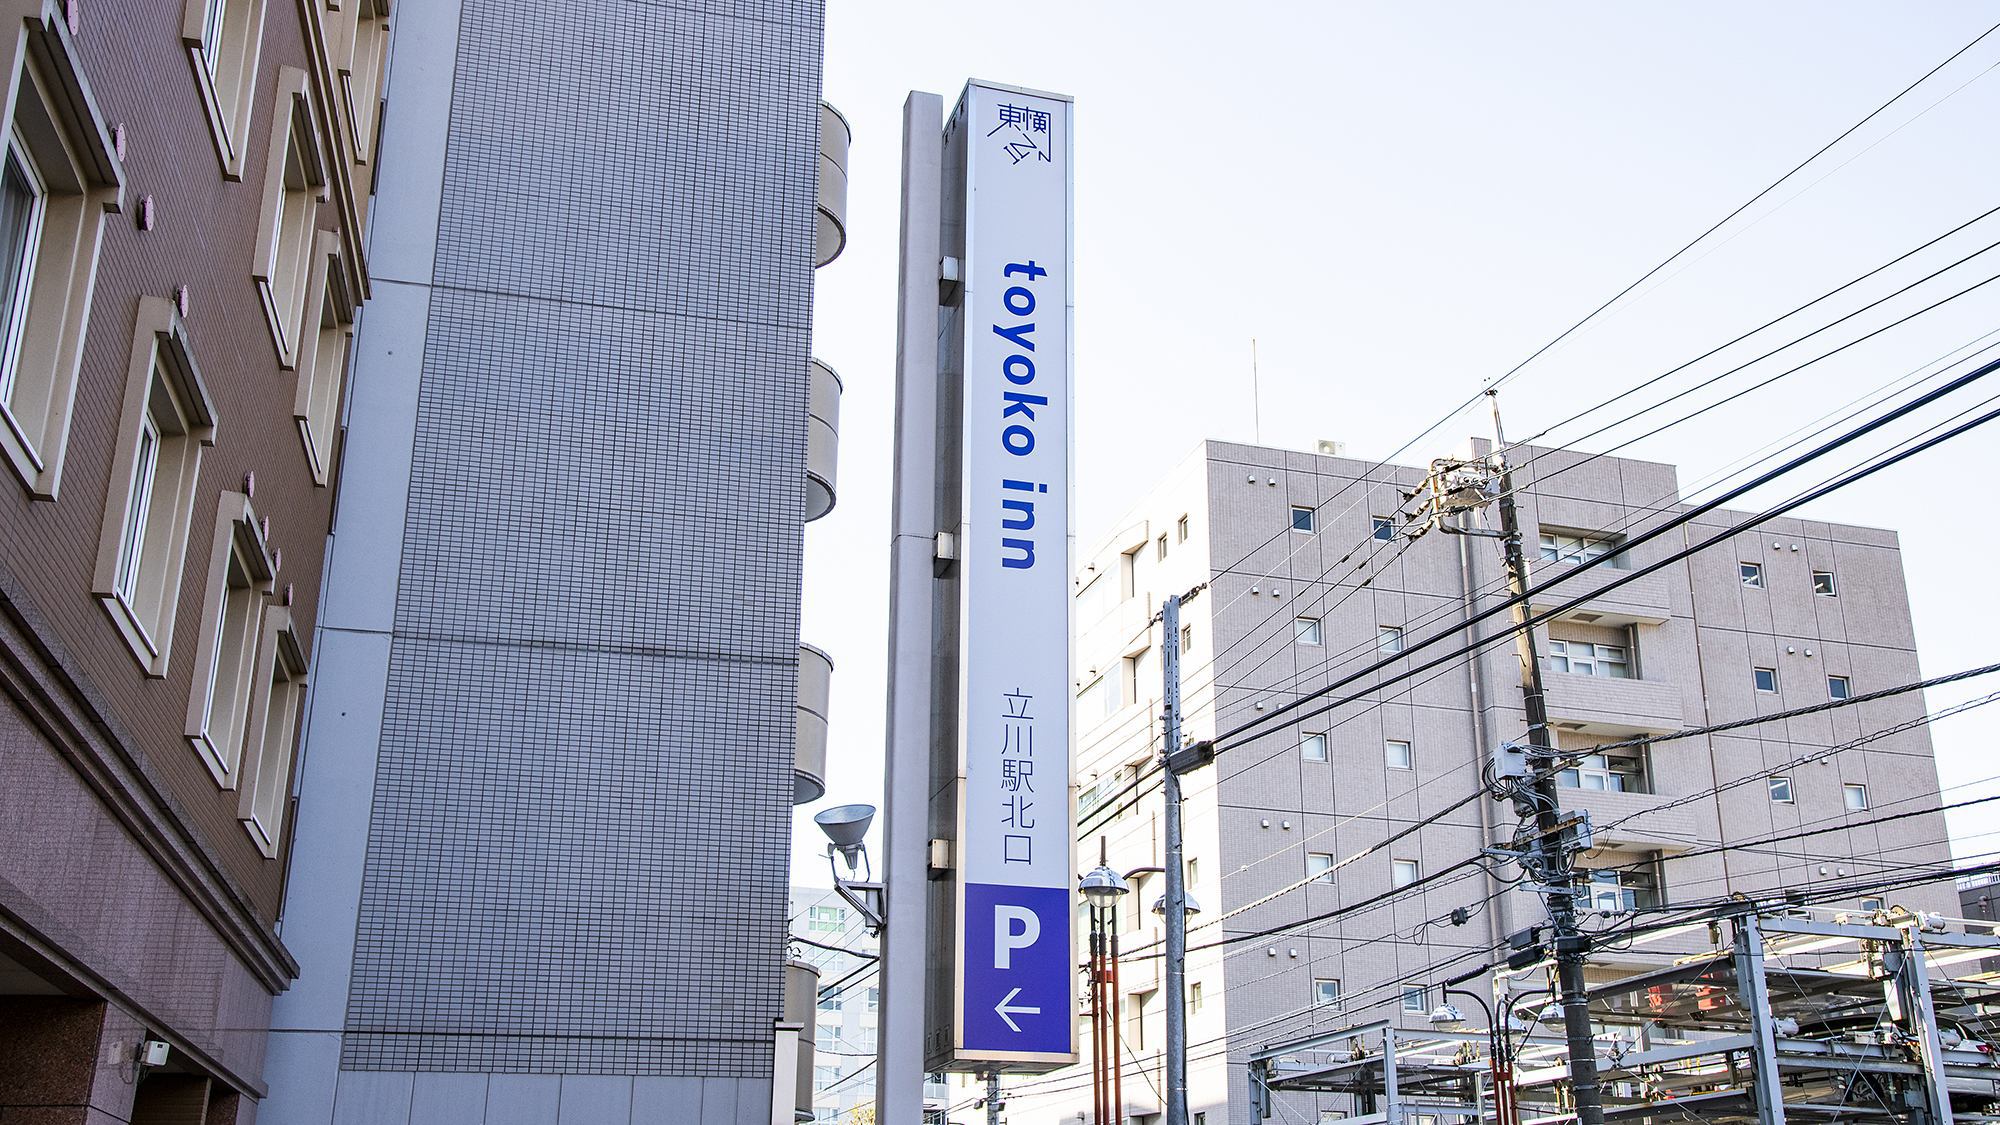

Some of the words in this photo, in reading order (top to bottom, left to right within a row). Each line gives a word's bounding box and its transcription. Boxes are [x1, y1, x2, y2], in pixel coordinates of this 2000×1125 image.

[992, 259, 1048, 457] toyoko
[1002, 478, 1048, 570] inn
[1001, 687, 1035, 866] 立川駅北口
[994, 904, 1041, 970] P
